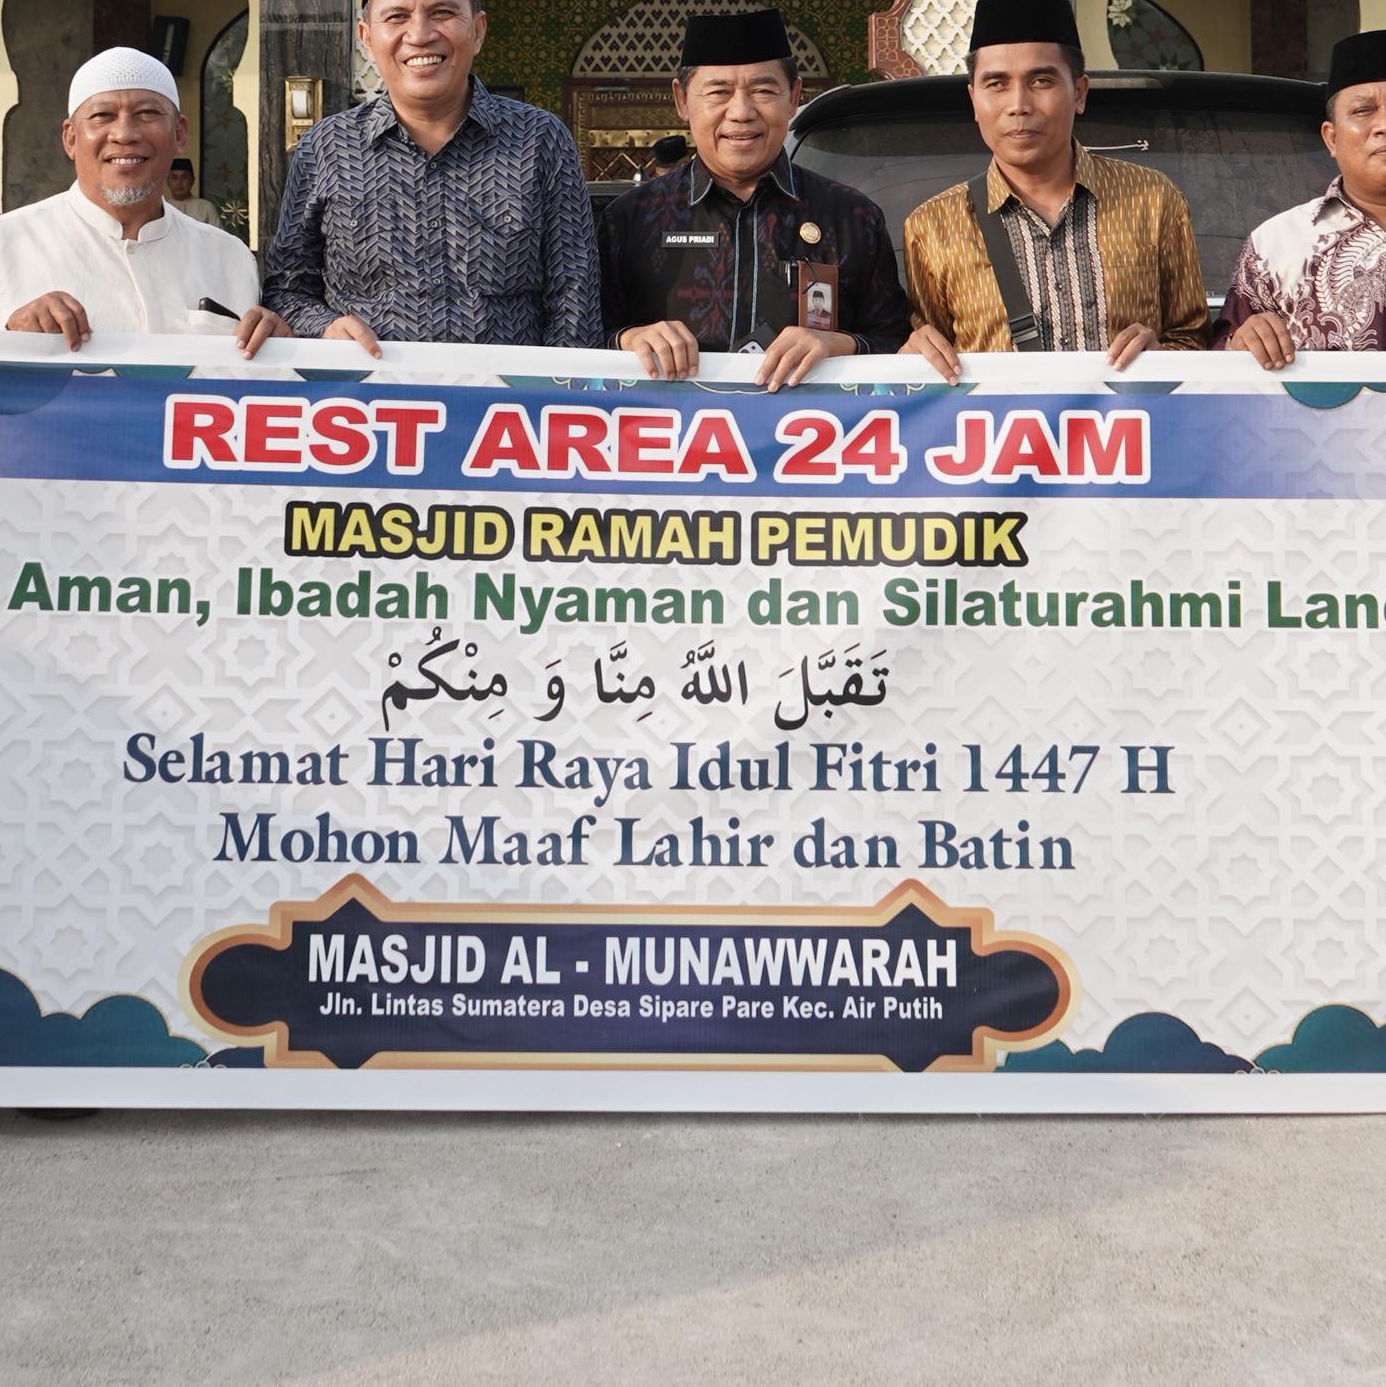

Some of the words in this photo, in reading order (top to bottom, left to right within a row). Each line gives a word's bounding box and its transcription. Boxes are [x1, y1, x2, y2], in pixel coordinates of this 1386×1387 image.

[666, 235, 687, 244] AGUS
[688, 235, 715, 244] PRIADI
[167, 397, 443, 472] REST
[466, 407, 752, 478] AREA
[777, 413, 904, 480] 24
[929, 413, 1147, 480] JAM
[290, 506, 511, 556] MASJID
[528, 511, 736, 560] RAMAH
[756, 515, 1024, 562] PEMUDIK
[6, 562, 211, 627] Aman,
[238, 566, 449, 620] Ibadah
[473, 572, 724, 634] Nyaman
[747, 578, 860, 626] dan
[882, 578, 1241, 629] Silaturahmi
[122, 732, 350, 785] Selamat
[367, 737, 498, 789] Hari
[516, 739, 653, 808] Raya
[669, 740, 790, 792] Idul
[808, 741, 941, 793] Fitri
[961, 743, 1101, 796] 1447
[1119, 744, 1177, 795] H
[213, 812, 420, 864] Mohon
[439, 815, 598, 866] Maaf
[613, 816, 775, 868] Lahir
[793, 817, 902, 870] dan
[917, 819, 1077, 871] Batin
[308, 933, 486, 984] MASJID
[499, 935, 562, 984] AL
[575, 959, 589, 973] -
[604, 937, 958, 987] MUNAWWARAH
[319, 992, 363, 1016] Jln.
[370, 992, 444, 1016] Lintas
[451, 993, 566, 1017] Sumatera
[573, 993, 631, 1018] Desa
[638, 994, 715, 1023] Sipare
[722, 995, 775, 1019] Pare
[782, 995, 835, 1020] Kec.
[842, 995, 876, 1020] Air
[883, 996, 944, 1021] Putih
